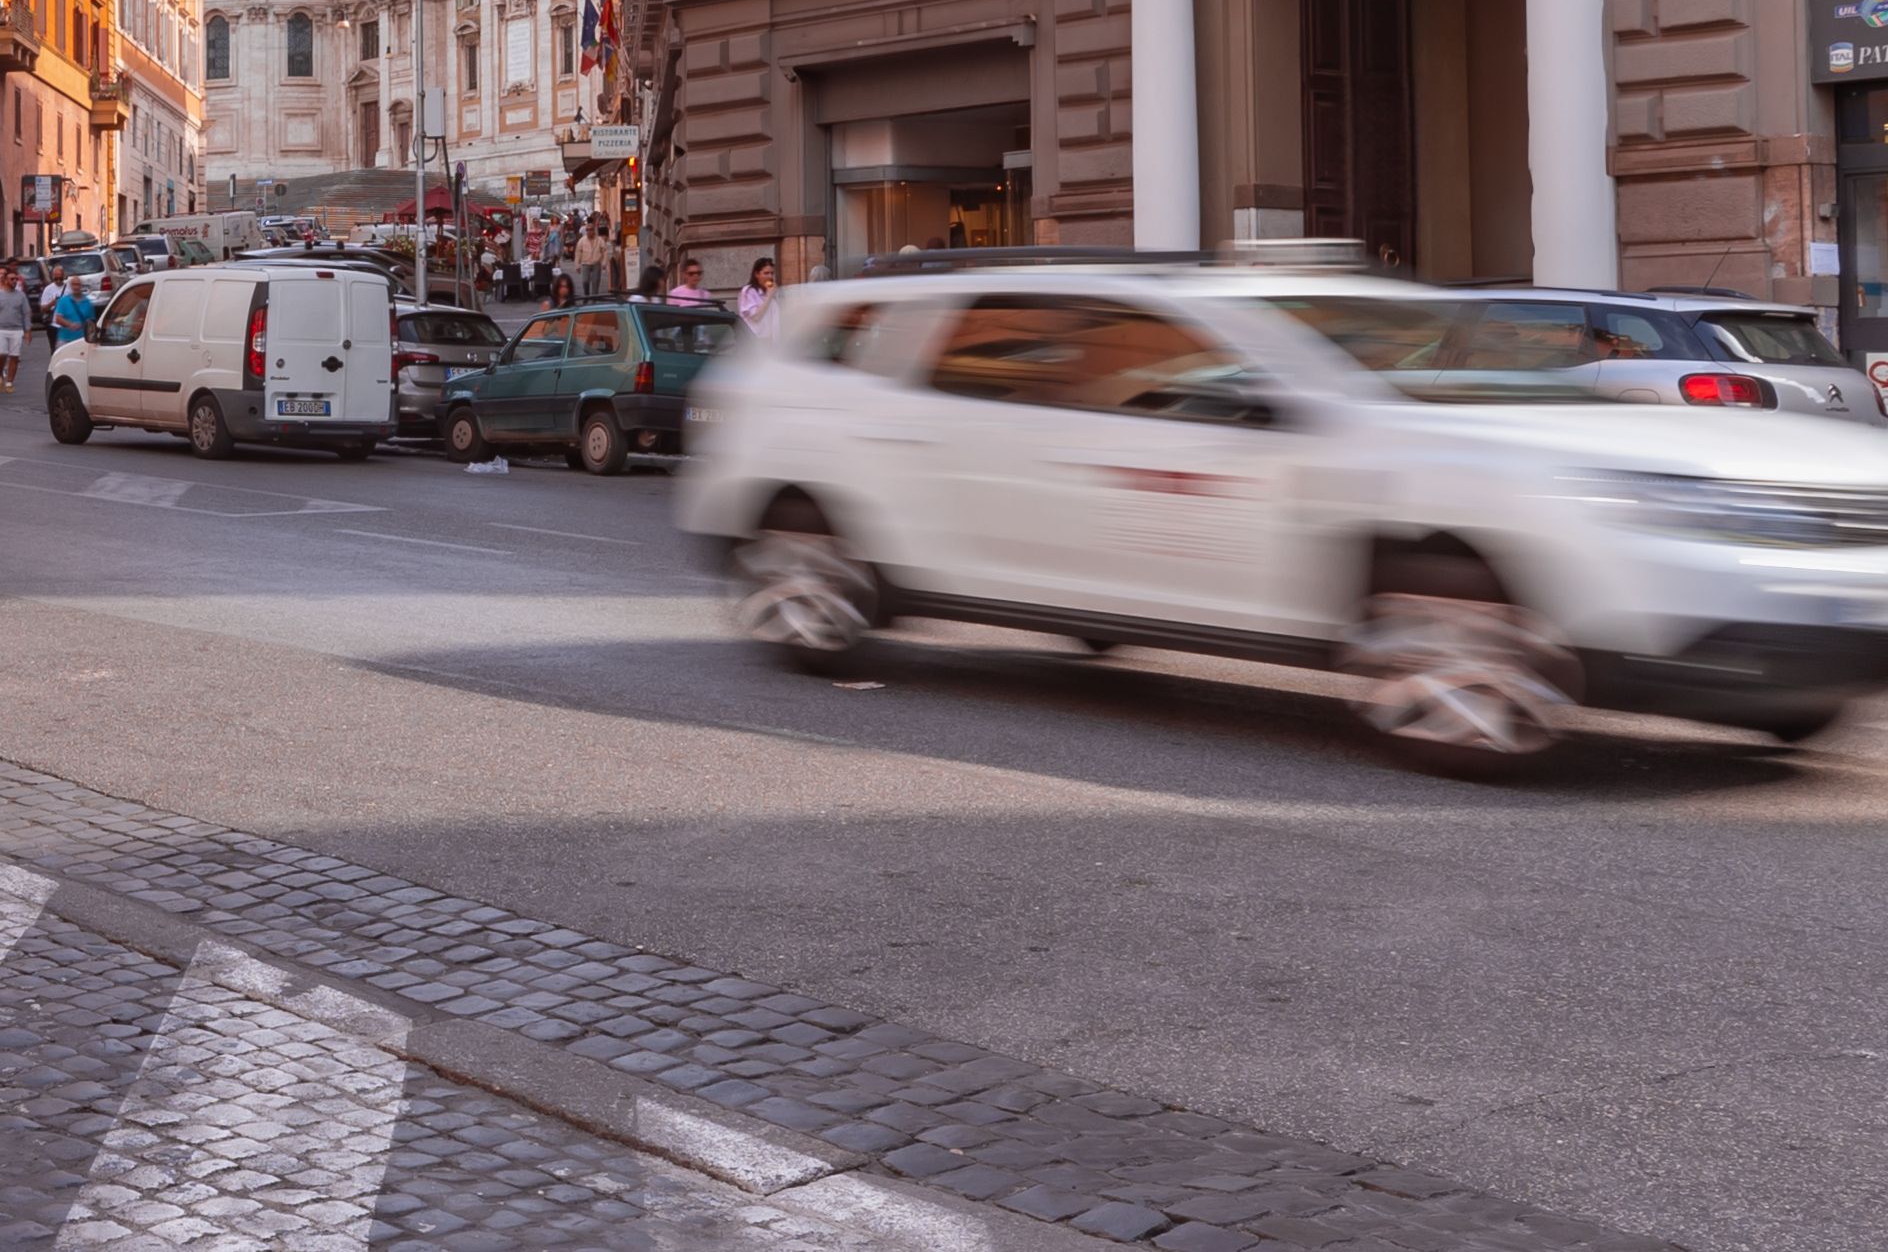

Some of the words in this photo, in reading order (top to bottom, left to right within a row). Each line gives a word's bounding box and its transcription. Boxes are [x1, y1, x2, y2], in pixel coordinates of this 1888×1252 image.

[1839, 6, 1857, 16] UIL
[592, 128, 637, 136] RISTORANTE
[598, 139, 632, 147] PIZZERIA
